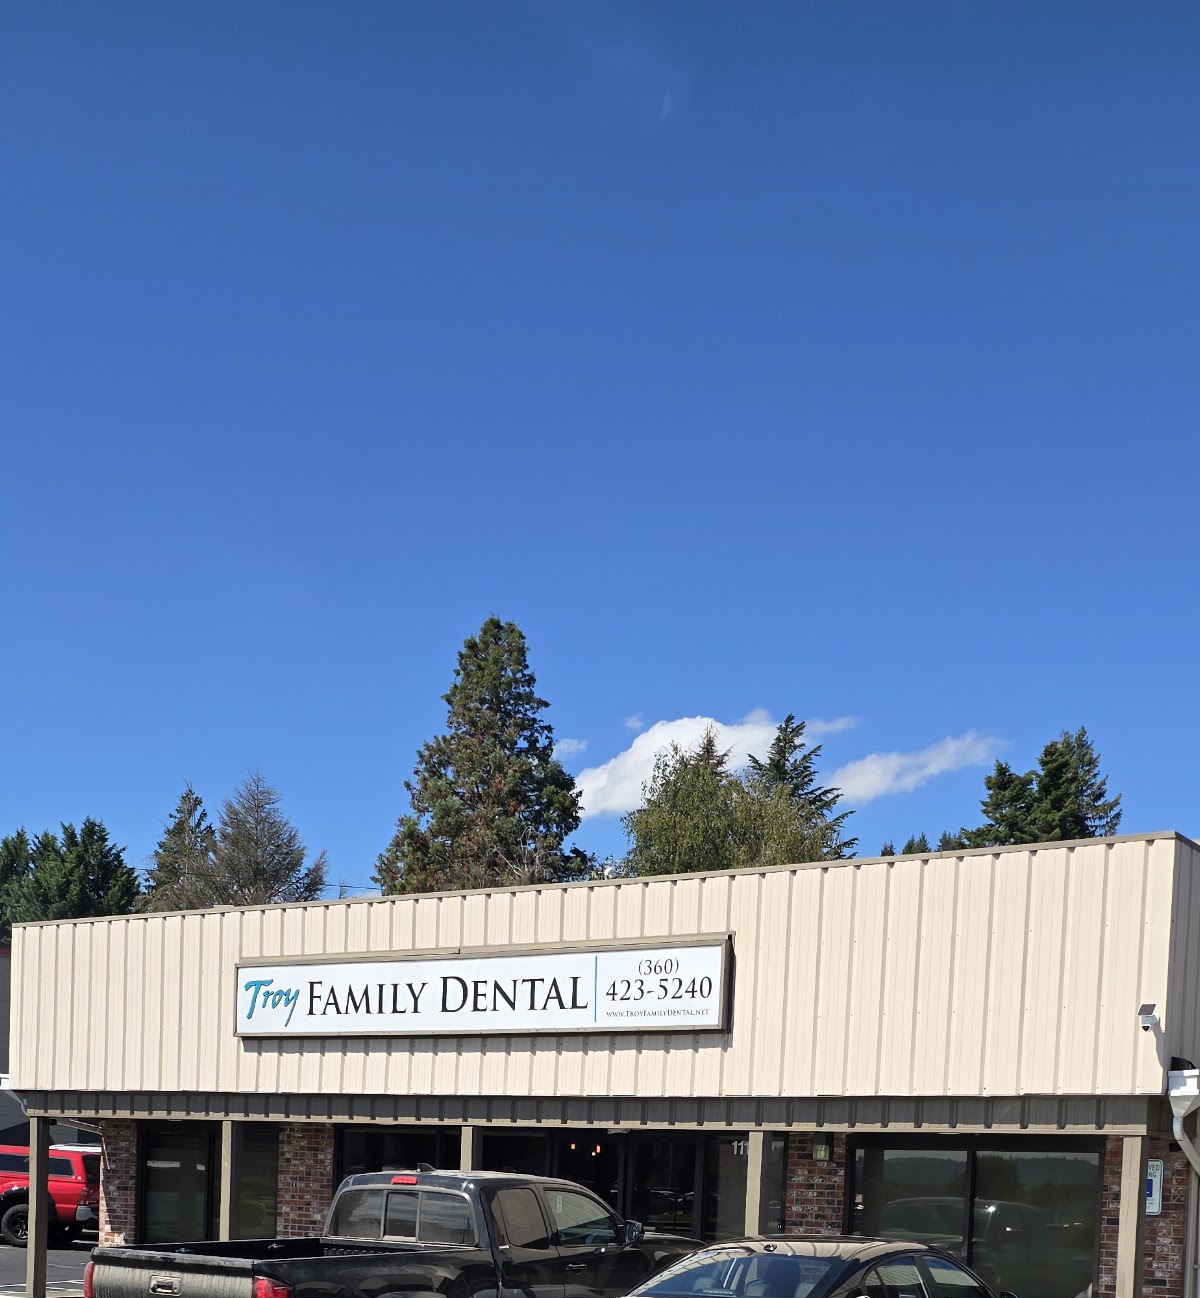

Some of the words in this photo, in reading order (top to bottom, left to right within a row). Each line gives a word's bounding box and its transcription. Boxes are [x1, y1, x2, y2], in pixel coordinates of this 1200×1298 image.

[638, 957, 679, 976] (360)
[244, 979, 300, 1027] Troy
[307, 981, 428, 1016] FAMILY
[440, 976, 588, 1013] DENTAL
[606, 976, 713, 1002] 423-5240
